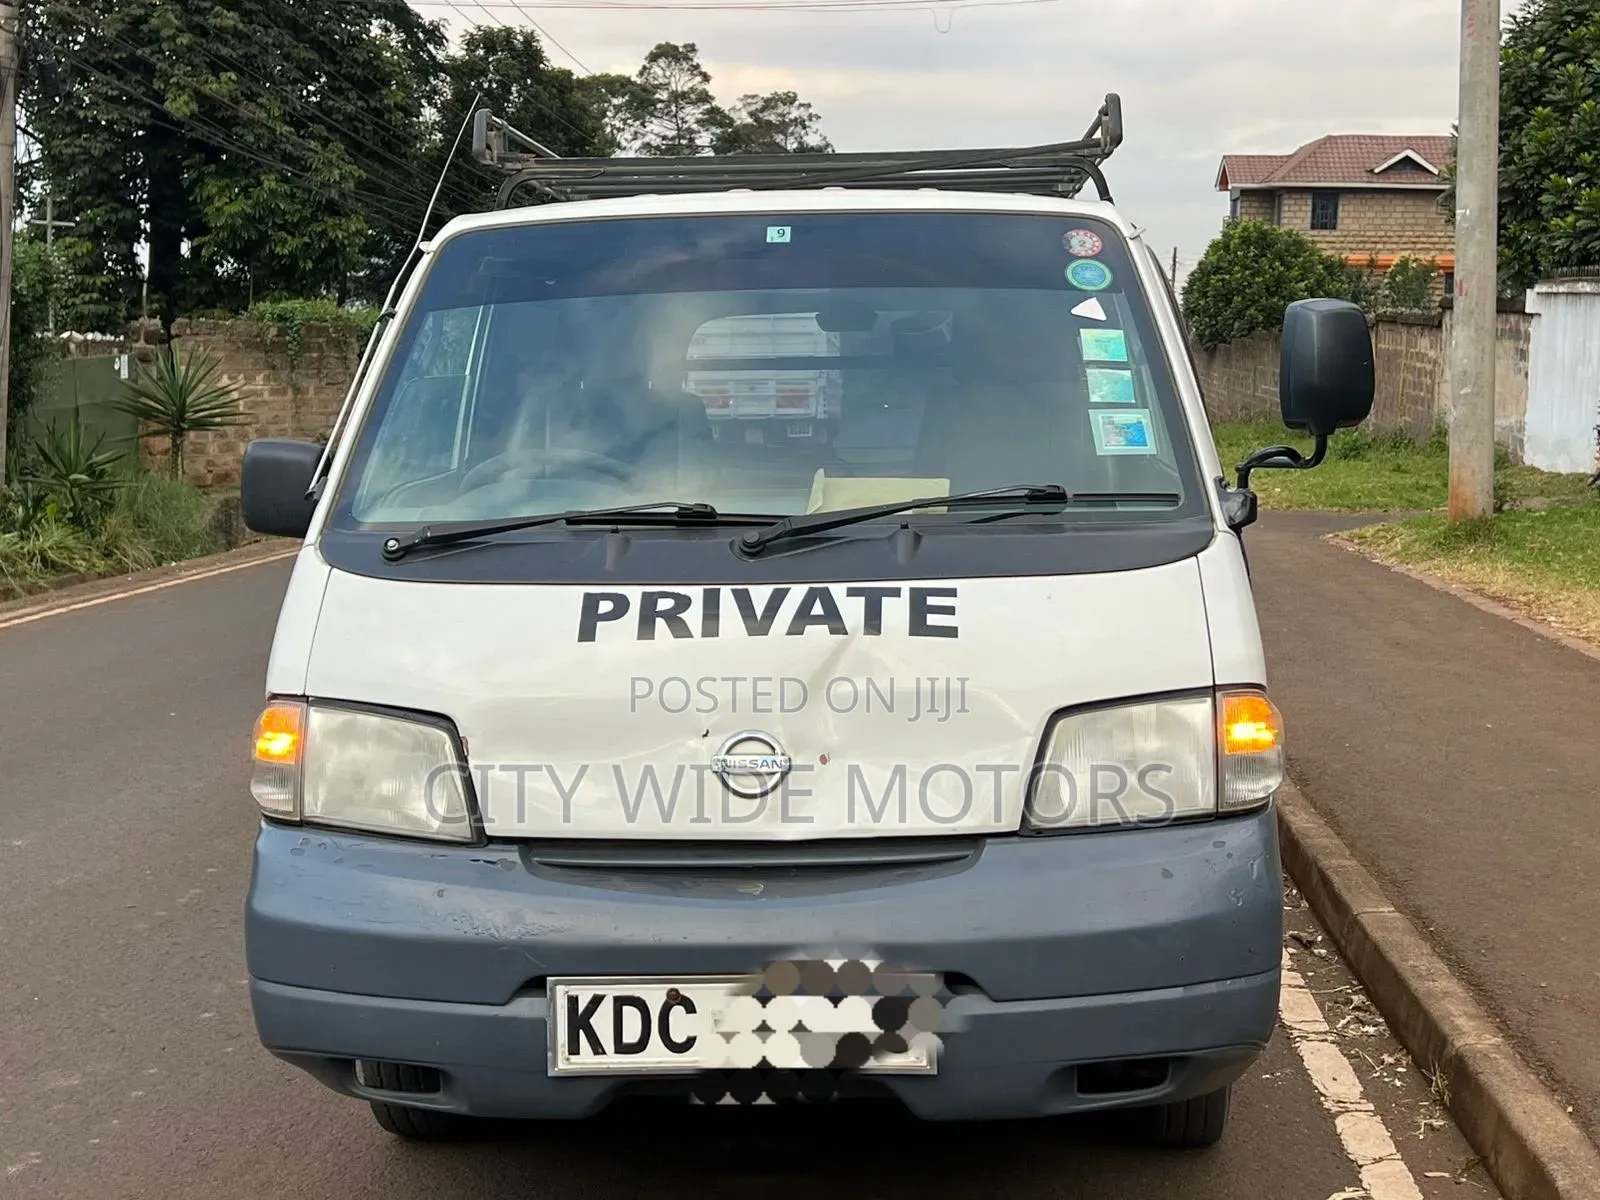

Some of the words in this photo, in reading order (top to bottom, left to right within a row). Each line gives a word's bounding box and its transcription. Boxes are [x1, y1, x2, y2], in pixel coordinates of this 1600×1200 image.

[777, 228, 785, 238] 9
[577, 586, 959, 643] PRIVATE
[720, 758, 784, 770] NISSAN
[566, 994, 698, 1056] KDC
